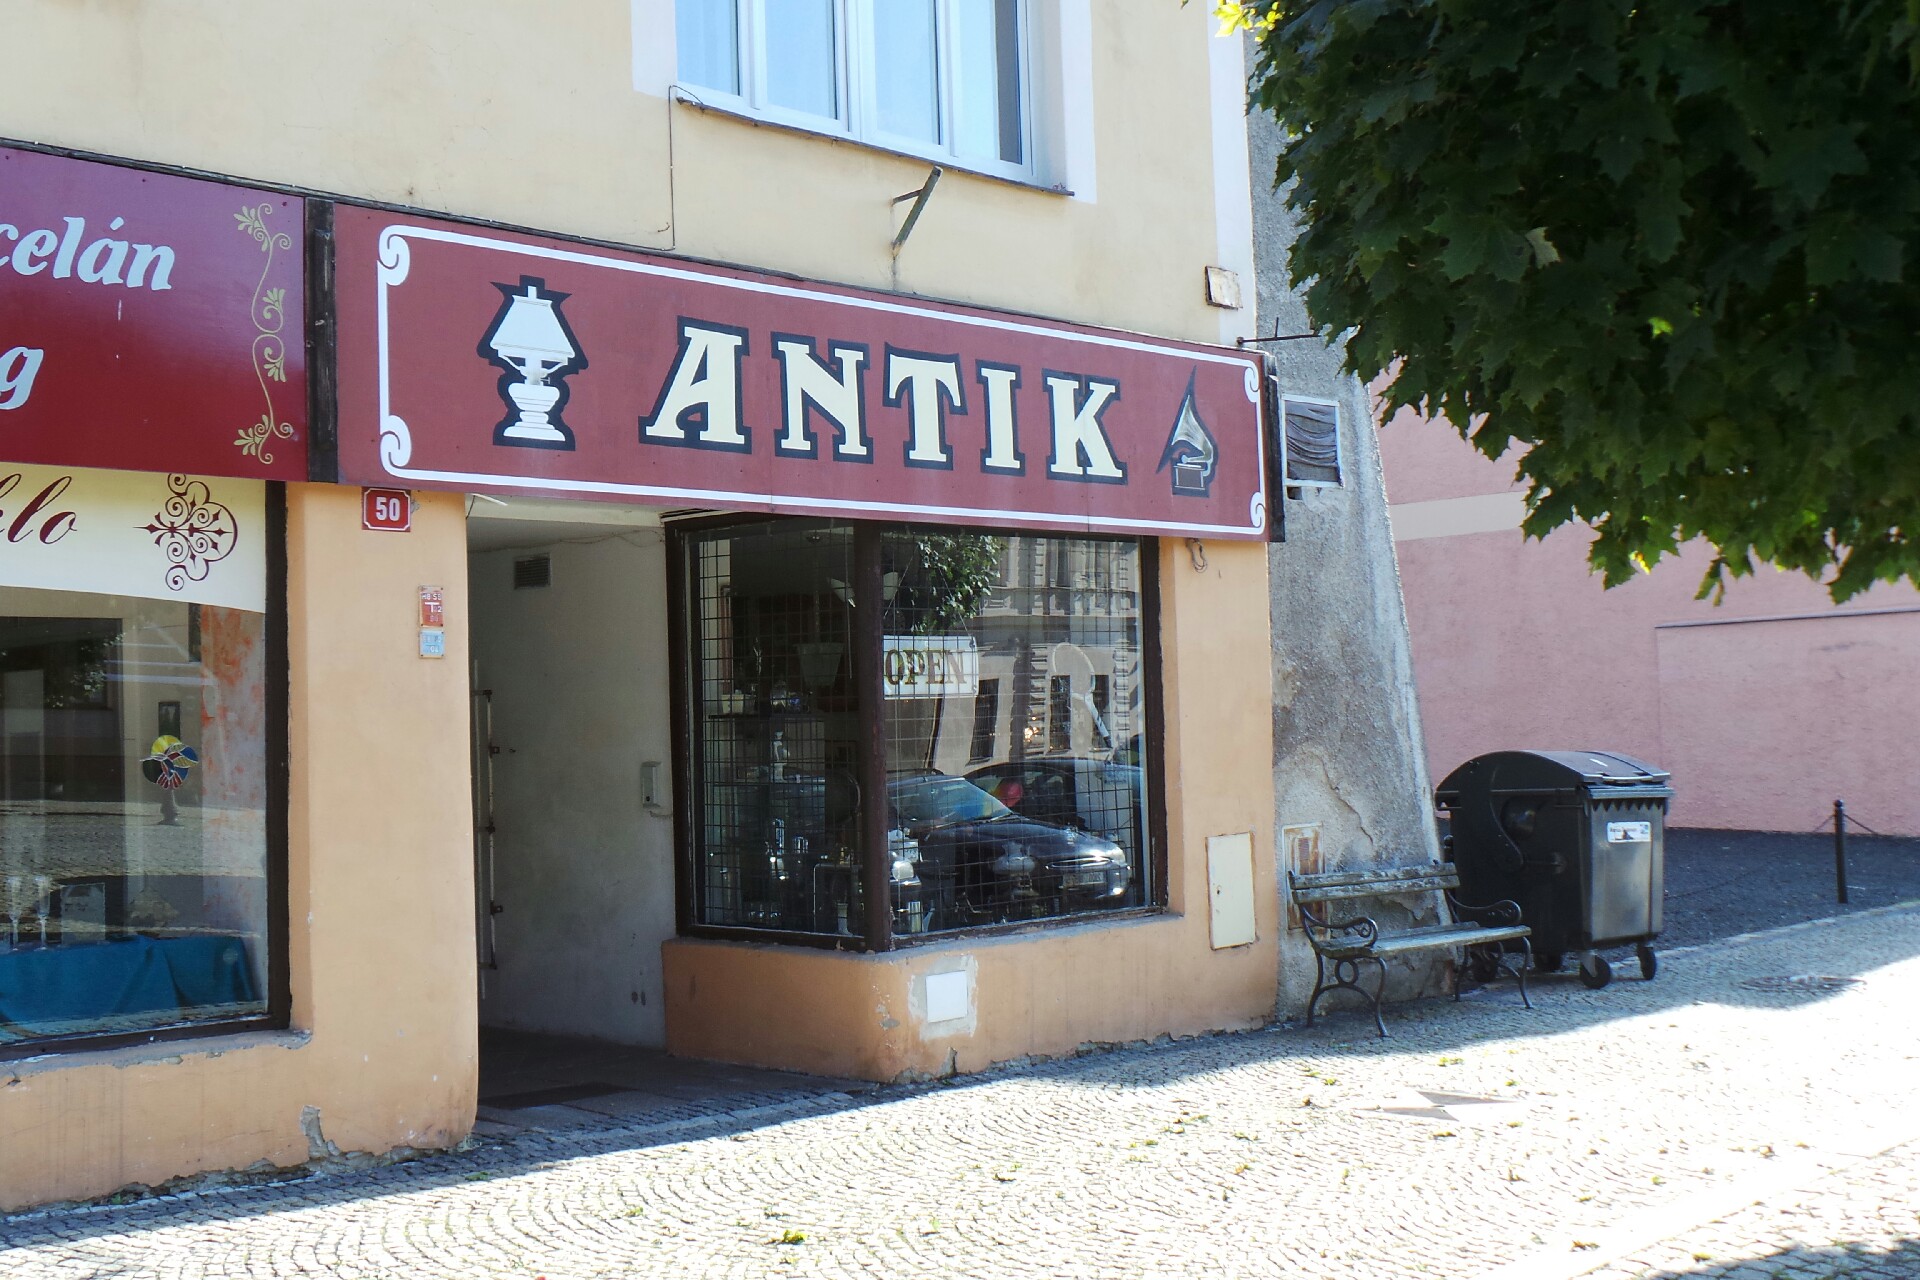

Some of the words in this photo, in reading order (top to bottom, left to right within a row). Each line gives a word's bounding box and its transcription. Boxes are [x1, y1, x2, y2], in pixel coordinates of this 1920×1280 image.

[639, 316, 1127, 485] ANTIK
[375, 496, 400, 522] 50
[884, 649, 968, 686] OPEN
